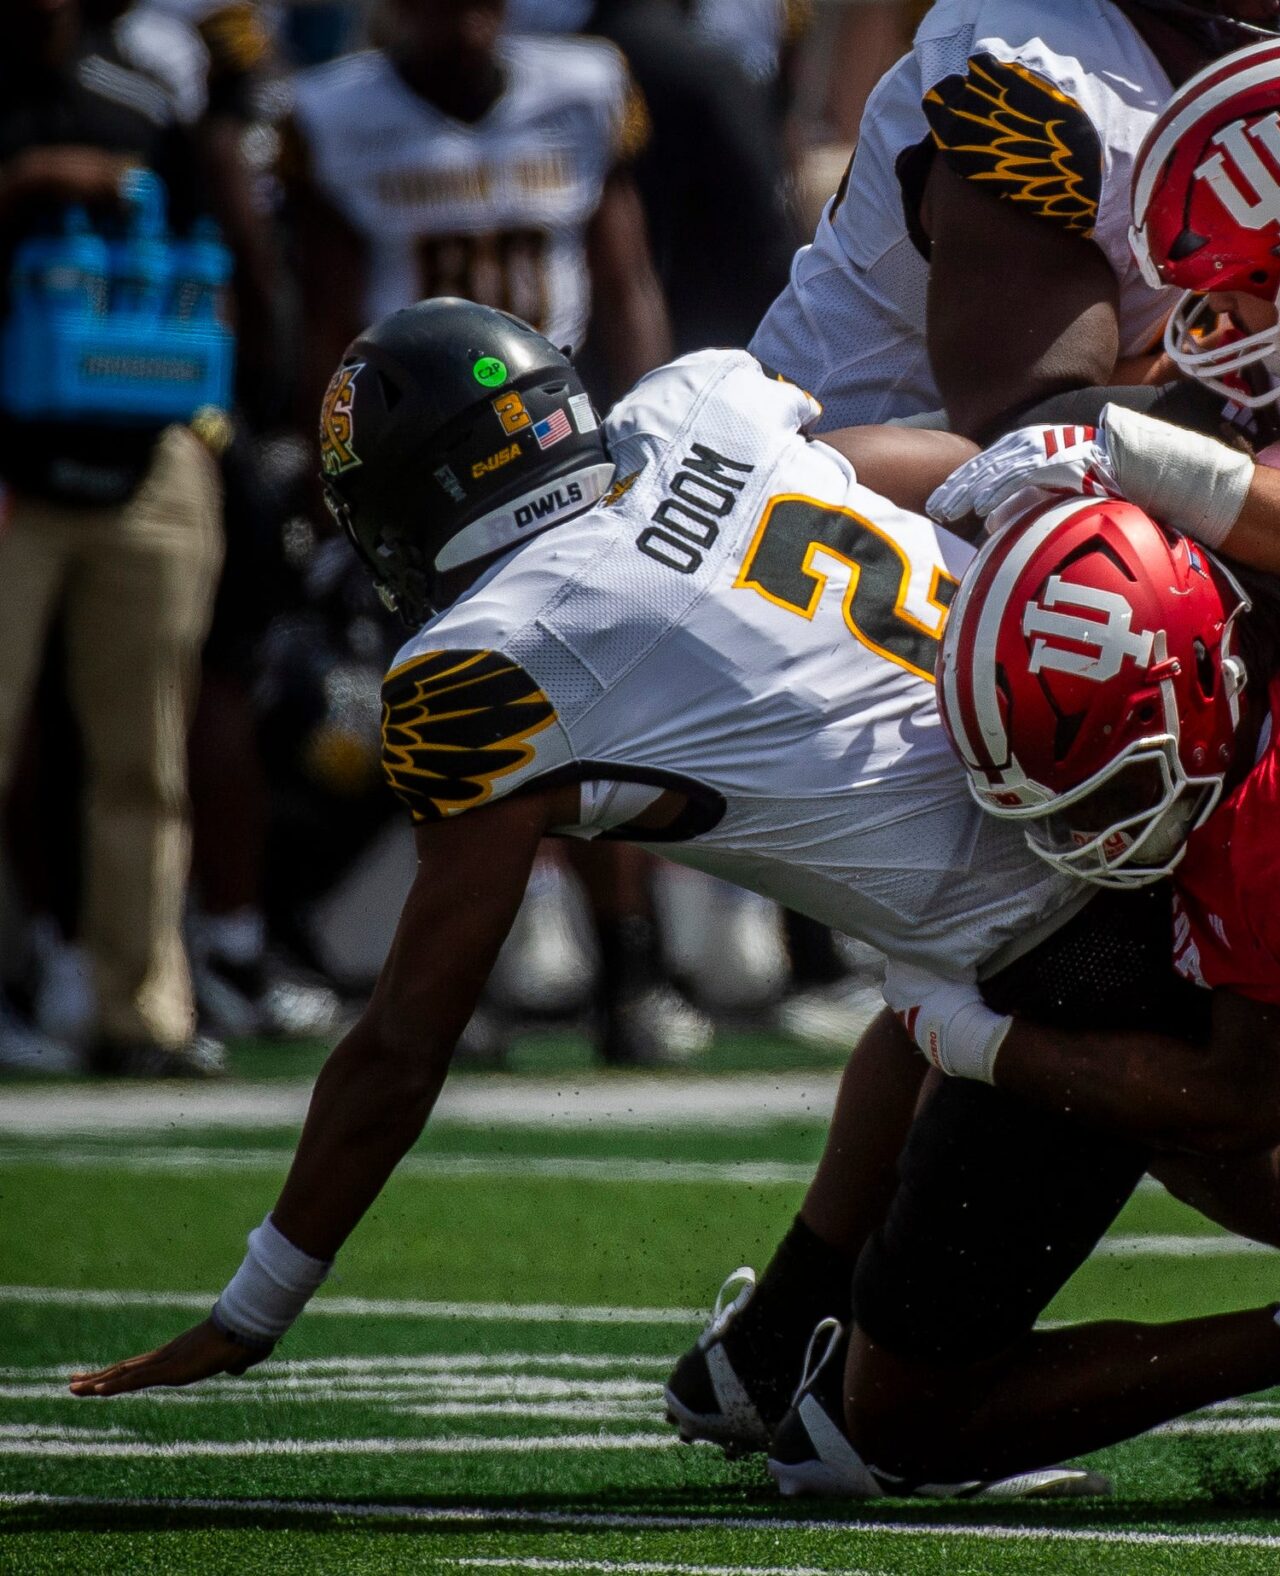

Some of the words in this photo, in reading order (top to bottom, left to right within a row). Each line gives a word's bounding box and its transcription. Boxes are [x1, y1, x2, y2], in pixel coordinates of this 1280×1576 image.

[477, 362, 501, 380] C2P
[491, 390, 534, 436] 2
[513, 482, 583, 528] OWLS
[635, 443, 754, 574] ODOM
[731, 492, 961, 684] 2
